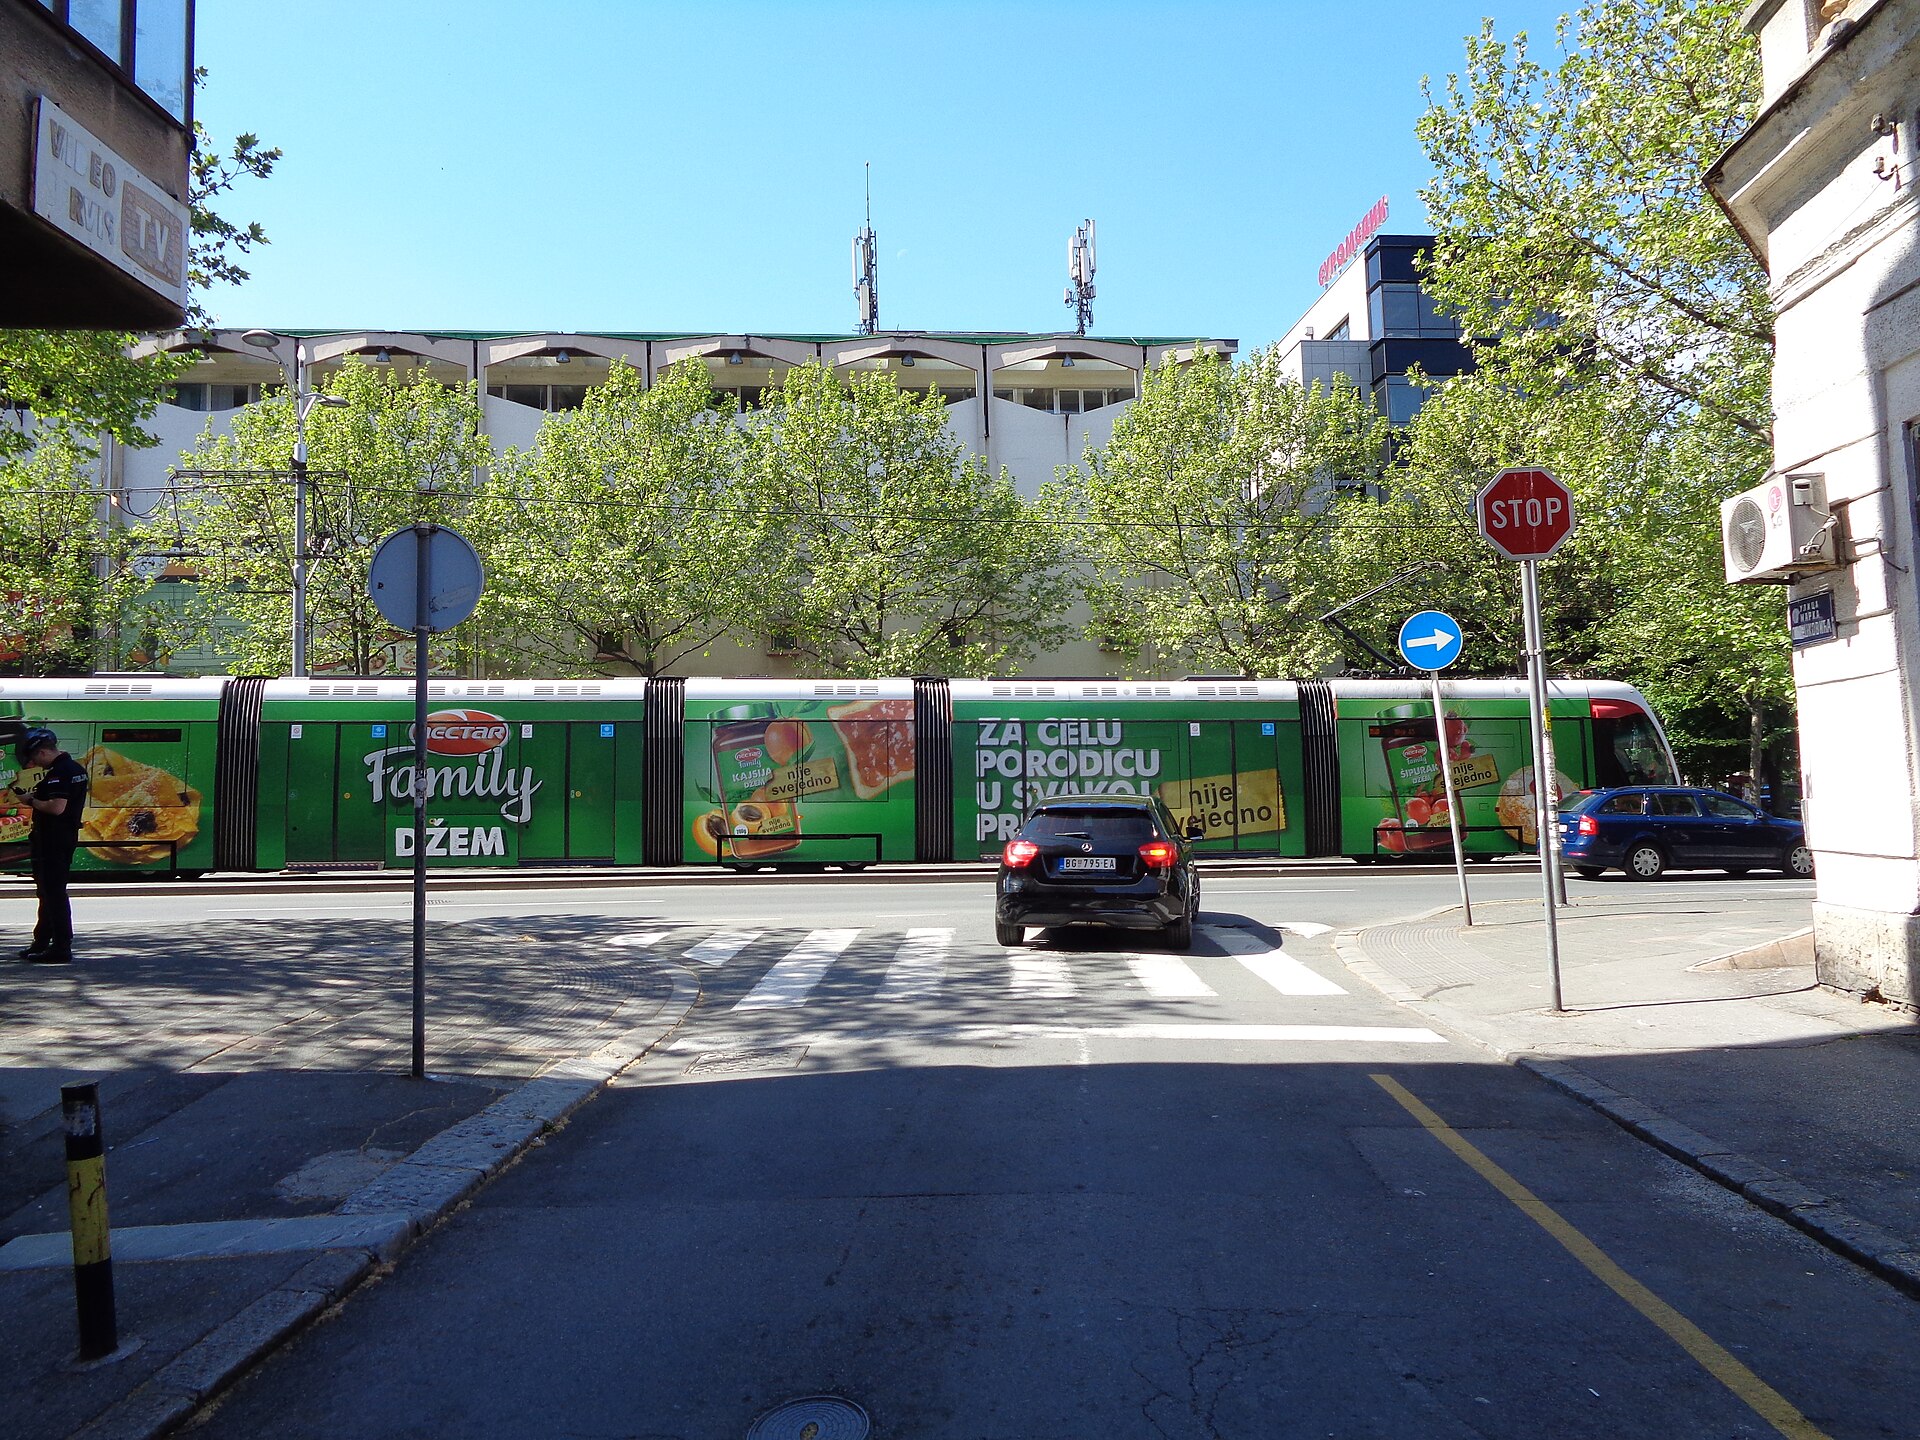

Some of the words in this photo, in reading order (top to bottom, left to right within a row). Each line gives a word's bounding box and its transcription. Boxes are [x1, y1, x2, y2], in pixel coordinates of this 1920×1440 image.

[135, 205, 170, 264] TV
[1491, 497, 1562, 529] STOP
[976, 718, 1027, 746] ZA
[1037, 717, 1122, 746] CELU
[732, 767, 773, 783] KAJSIJA
[787, 766, 811, 781] nije
[976, 749, 1160, 778] PORODICU
[1453, 763, 1474, 775] nije
[363, 746, 543, 823] Family
[771, 775, 832, 796] svejedno
[1440, 770, 1492, 789] sejedno
[976, 781, 1002, 810] U
[1189, 782, 1233, 809] nije
[395, 818, 505, 857] DŽEM
[1065, 858, 1077, 868] BG
